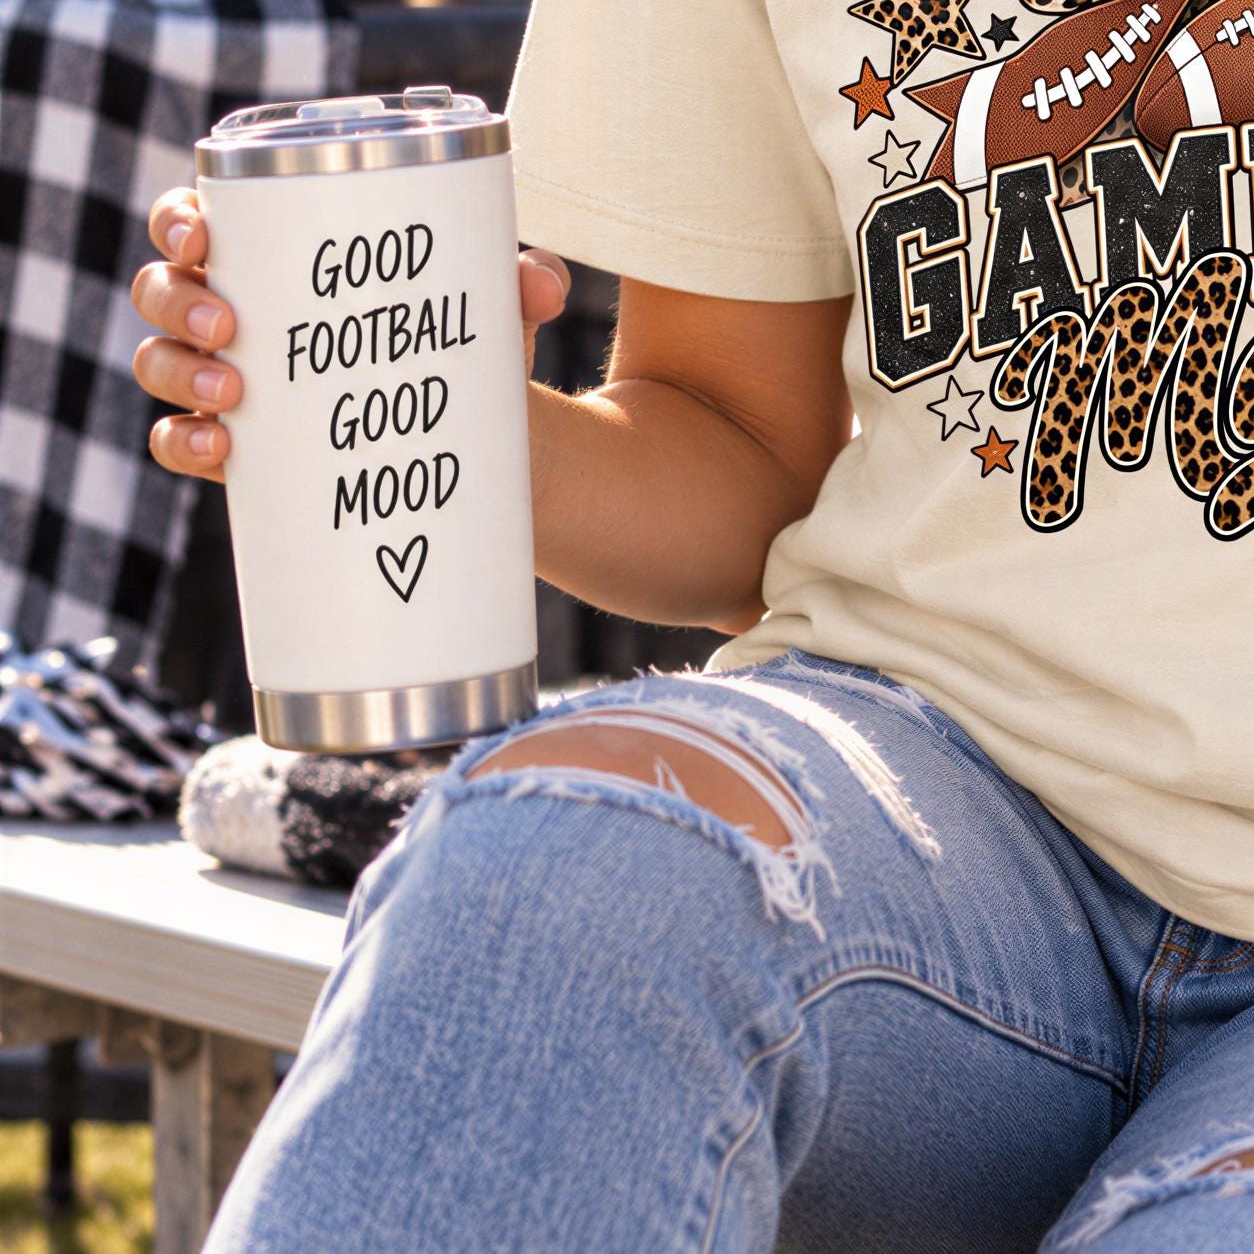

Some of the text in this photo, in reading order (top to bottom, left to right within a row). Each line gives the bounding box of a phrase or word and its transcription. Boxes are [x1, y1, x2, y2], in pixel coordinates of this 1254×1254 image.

[311, 222, 434, 299] GOOD
[286, 291, 477, 382] FOOTBALL
[330, 375, 449, 451] GOOD
[333, 451, 461, 530] MOOD
